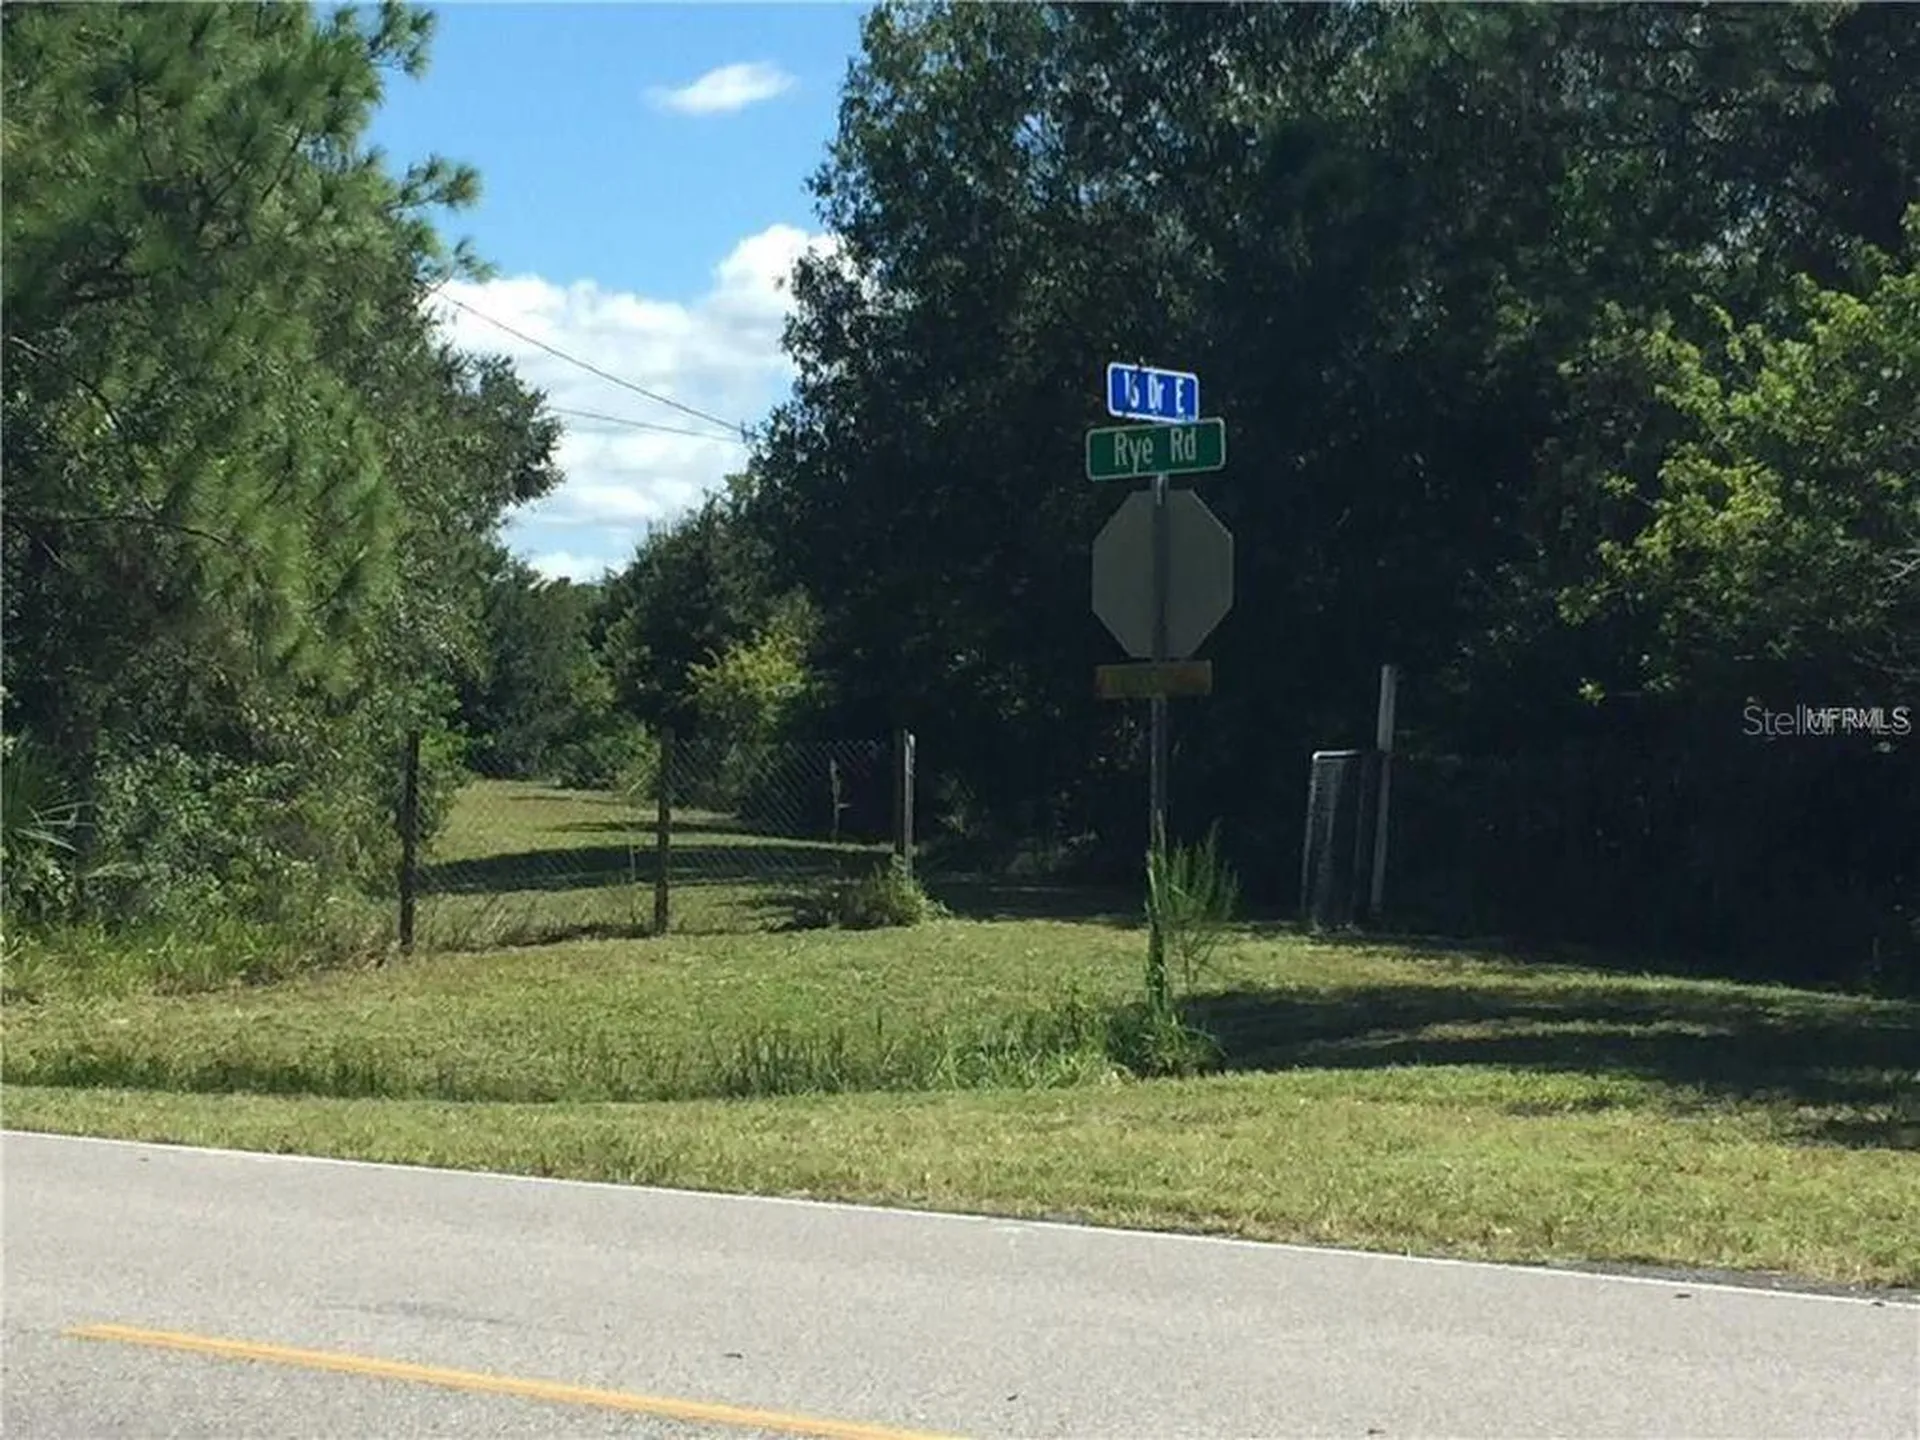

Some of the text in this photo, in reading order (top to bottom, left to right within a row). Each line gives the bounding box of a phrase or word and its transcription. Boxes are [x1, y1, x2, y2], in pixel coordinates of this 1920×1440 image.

[1148, 373, 1165, 410] Dr
[1175, 378, 1185, 414] E
[1113, 427, 1197, 474] Rye Rd
